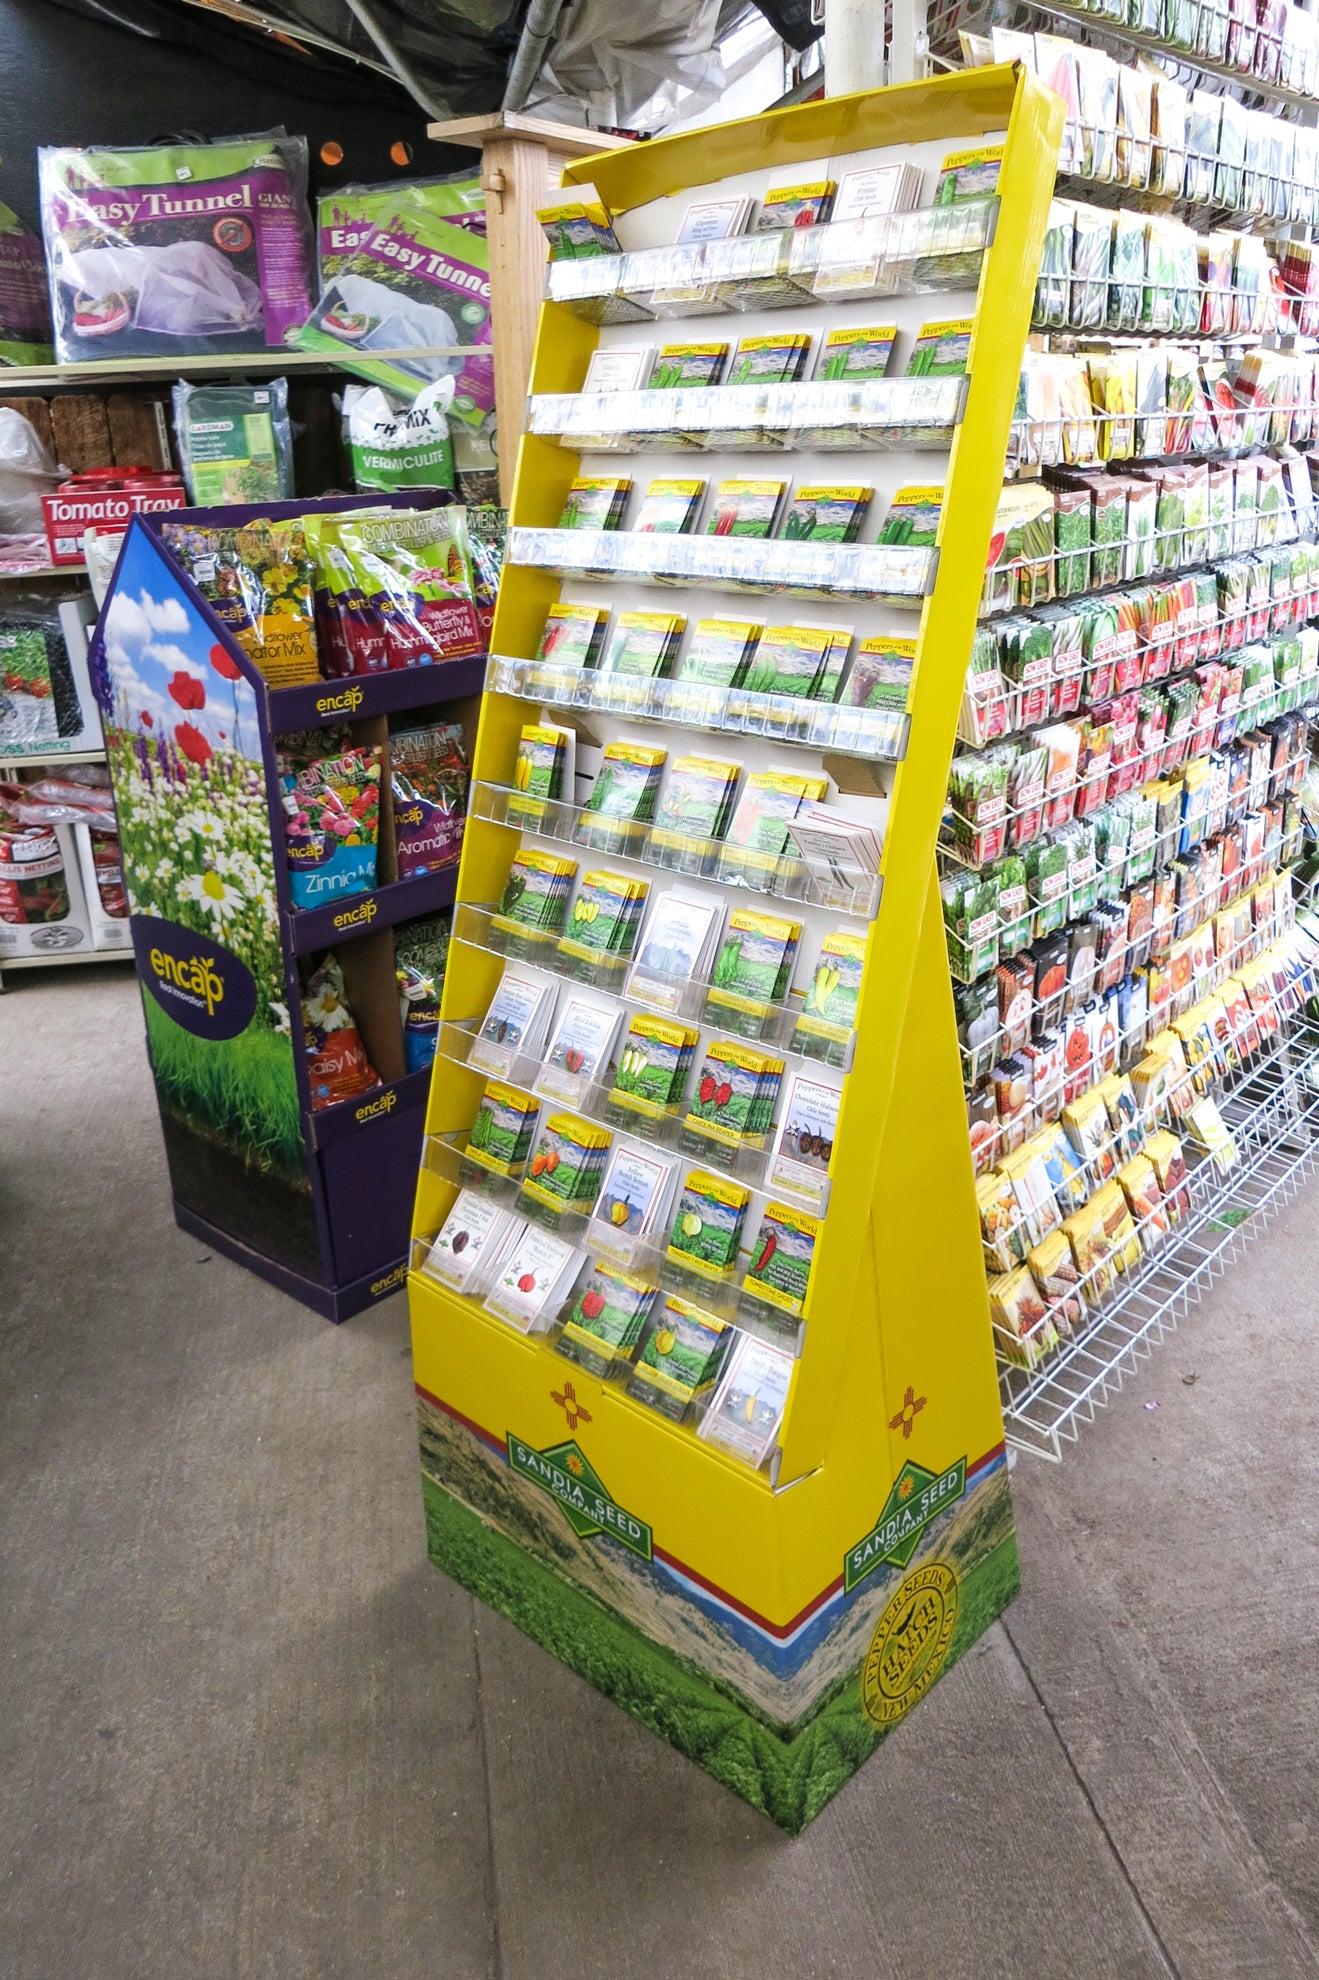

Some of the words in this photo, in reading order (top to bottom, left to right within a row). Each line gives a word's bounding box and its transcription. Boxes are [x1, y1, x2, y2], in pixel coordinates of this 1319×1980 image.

[946, 153, 976, 167] Peppers
[986, 148, 1003, 158] Worl
[66, 198, 142, 225] Easy
[143, 185, 253, 216] Tunnel
[769, 191, 794, 202] Peppers
[803, 186, 822, 196] World
[331, 230, 369, 249] Eas
[370, 233, 427, 271] Easy
[425, 253, 491, 298] Tunne
[833, 332, 860, 343] Peppers
[869, 329, 890, 339] World
[922, 325, 950, 337] Peppers
[664, 346, 690, 356] Peppers
[696, 344, 716, 354] World
[743, 340, 765, 350] Peppers
[772, 336, 791, 346] World
[362, 449, 444, 471] VERMICULITE
[801, 488, 826, 499] Peppers
[835, 489, 856, 499] World
[897, 493, 925, 504] Peppers
[47, 499, 129, 521] Tomato
[362, 511, 449, 544] COMBINATION
[423, 616, 465, 633] Butterfly
[457, 629, 474, 639] Mix
[282, 641, 307, 657] Mix
[766, 634, 793, 646] Peppers
[801, 637, 821, 649] World
[866, 643, 894, 652] Peppers
[316, 686, 364, 712] encap
[29, 740, 71, 753] Netting
[391, 730, 447, 755] MBINATION
[394, 805, 424, 826] ncap
[434, 815, 466, 833] Wildflwer
[397, 833, 451, 857] Aromatic
[24, 858, 61, 872] NETTING
[305, 869, 357, 894] Zinnia
[333, 898, 378, 927] encap
[733, 918, 757, 929] Peppers
[765, 925, 786, 938] World
[827, 941, 850, 952] Peppers
[150, 948, 224, 1017] encap
[409, 1009, 441, 1022] enca
[633, 1022, 655, 1033] Peppers
[662, 1030, 679, 1044] World
[710, 1047, 733, 1059] Peppers
[740, 1055, 758, 1069] World
[488, 1086, 505, 1097] Peppers
[510, 1096, 525, 1109] World
[798, 1083, 821, 1093] Peppers
[355, 1090, 397, 1120] encap
[794, 1093, 819, 1106] Chocolate
[820, 1100, 839, 1113] Haban
[806, 1105, 817, 1114] Chile
[548, 1119, 566, 1130] Peppers
[571, 1129, 587, 1143] World
[689, 1180, 712, 1192] Peppers
[718, 1188, 738, 1205] World
[769, 1207, 791, 1221] Peppers
[800, 1216, 818, 1235] World
[370, 1263, 408, 1294] encap
[750, 1278, 778, 1295] TOMBSTONE
[777, 1291, 793, 1304] GHOST
[517, 1446, 585, 1502] SANDIA
[595, 1499, 641, 1539] SEED
[551, 1483, 605, 1525] COMPANY
[854, 1508, 912, 1569] SANDIA
[921, 1471, 958, 1510] SEED
[884, 1509, 928, 1552] COMPANY
[867, 1599, 902, 1685] PEPPER
[904, 1569, 945, 1595] SEEDS
[882, 1595, 937, 1677] HATCH
[889, 1615, 938, 1688] SEEDS
[879, 1696, 909, 1719] NEW
[914, 1608, 955, 1692] MEXICO
